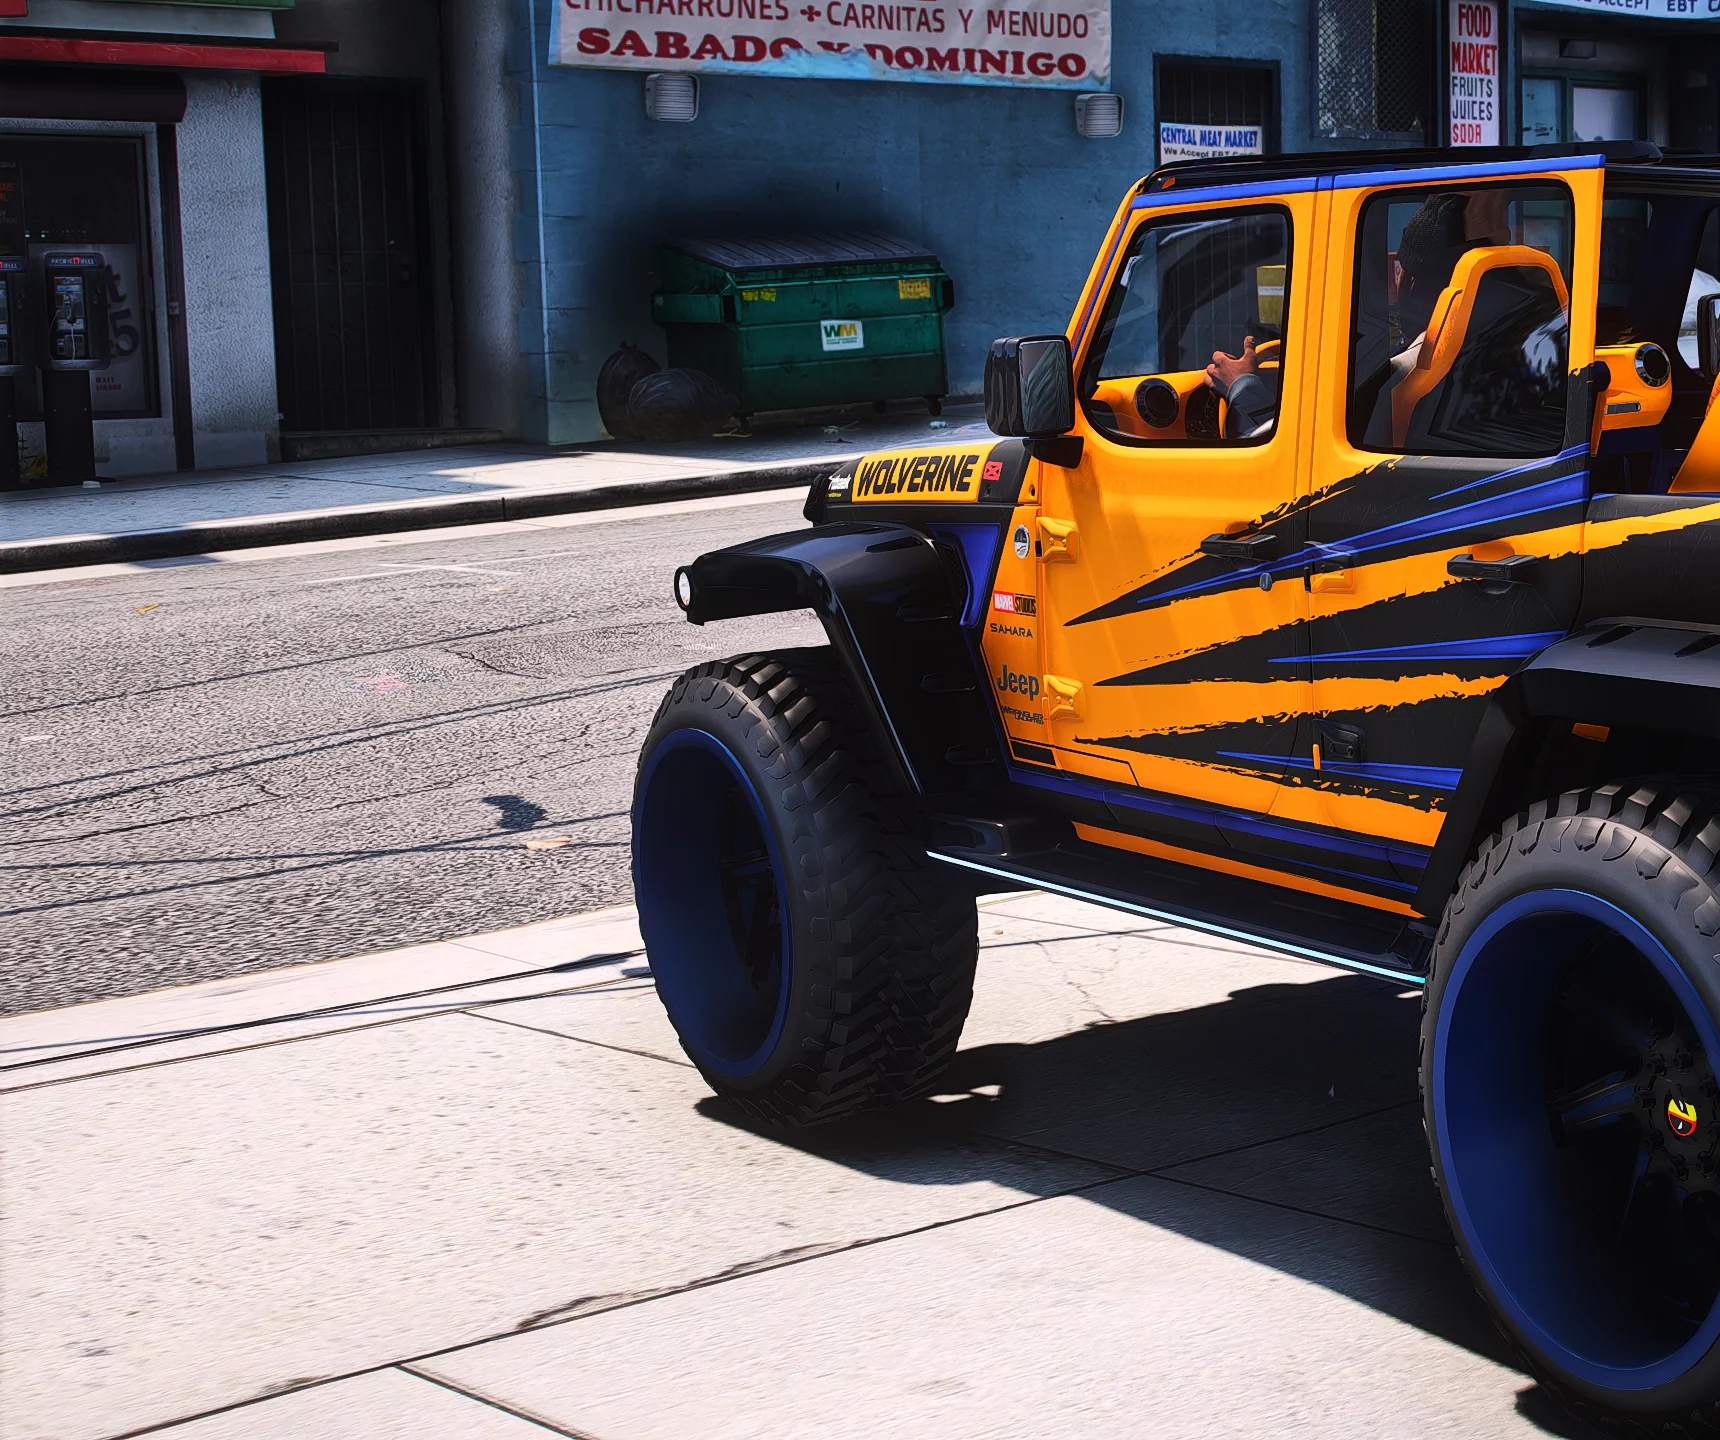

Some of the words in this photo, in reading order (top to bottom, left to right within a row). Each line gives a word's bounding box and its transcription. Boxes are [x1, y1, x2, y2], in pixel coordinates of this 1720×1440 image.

[1667, 0, 1696, 13] EBT
[827, 1, 945, 33] CARNITAS
[959, 9, 974, 33] Y
[987, 9, 1088, 38] MENUDO
[1458, 4, 1492, 38] FOOD
[577, 27, 803, 62] SABADO
[863, 43, 1087, 77] DOMINIGO
[1451, 41, 1497, 76] MARKET
[1452, 76, 1493, 98] FRUITS
[1452, 99, 1493, 121] JUICES
[1161, 127, 1197, 146] CENTRAL
[1200, 130, 1222, 147] MEAT
[1224, 130, 1258, 148] MARKET
[1452, 123, 1482, 144] SODA
[1164, 147, 1178, 155] We
[1180, 148, 1209, 158] Accept
[823, 324, 858, 337] WM
[857, 455, 979, 497] WOLVERINE
[1014, 596, 1037, 615] STUDIOS
[990, 622, 1034, 639] SAHARA
[996, 664, 1040, 701] Jeep
